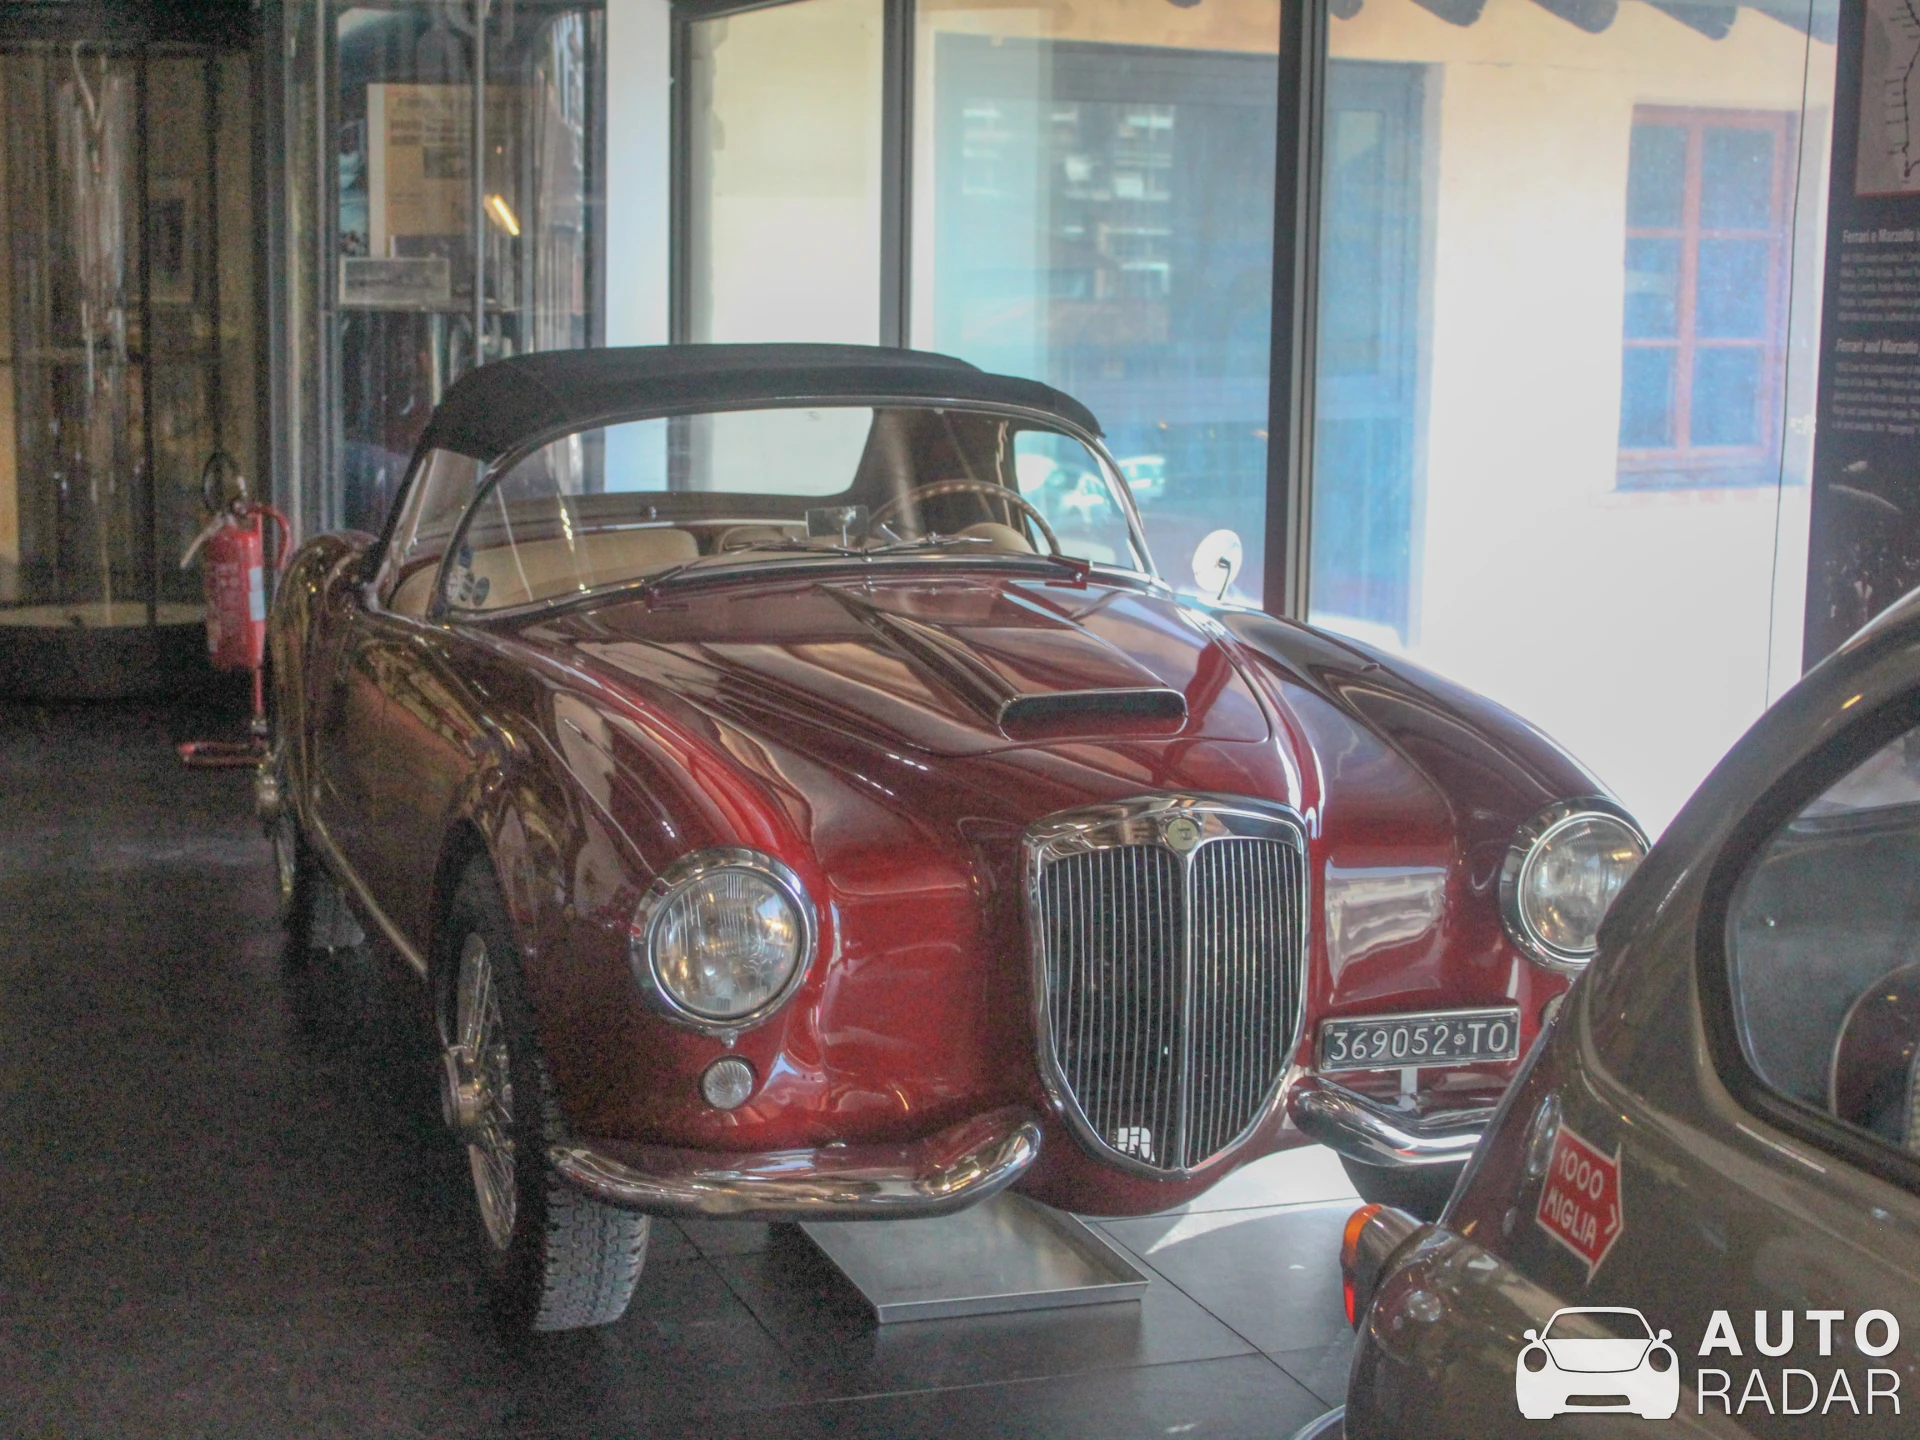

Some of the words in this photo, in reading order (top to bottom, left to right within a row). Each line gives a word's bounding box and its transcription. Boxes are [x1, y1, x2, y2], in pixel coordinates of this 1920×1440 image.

[1330, 1025, 1450, 1061] 369052
[1467, 1022, 1509, 1054] TO
[1558, 1147, 1604, 1200] 1000
[1544, 1186, 1598, 1249] MIGLIA
